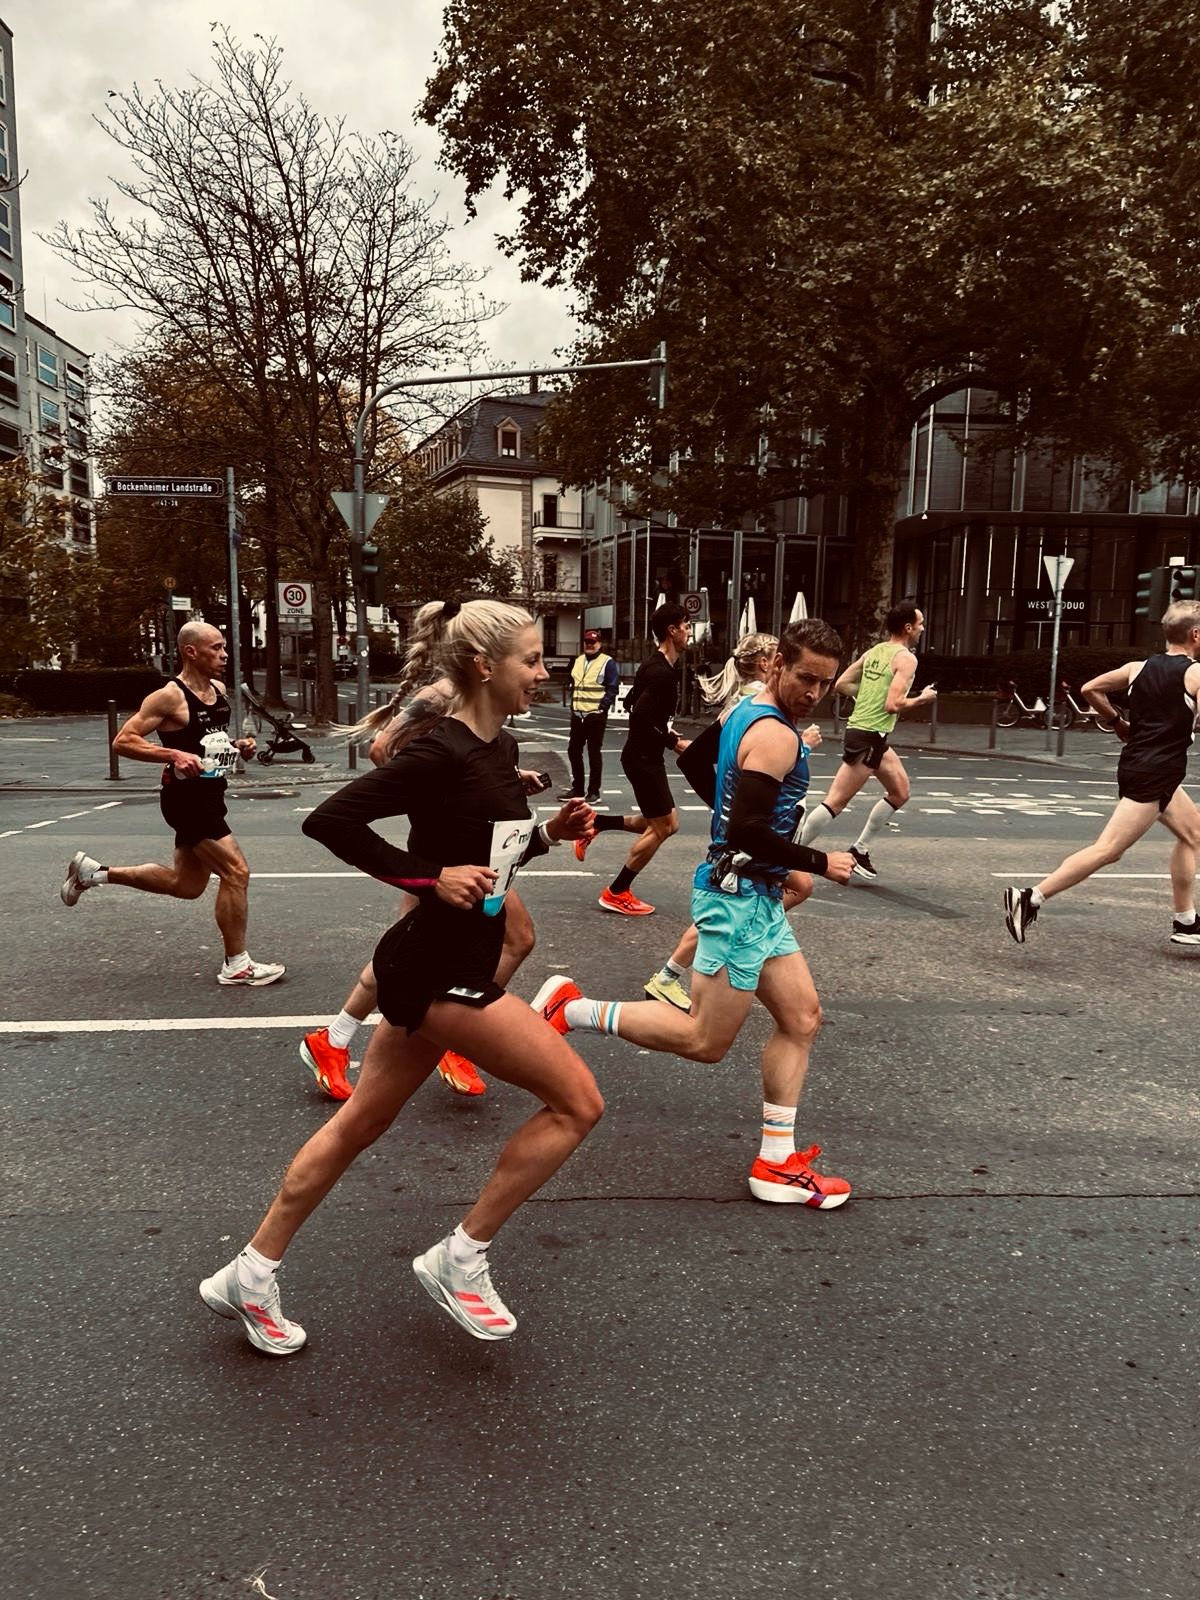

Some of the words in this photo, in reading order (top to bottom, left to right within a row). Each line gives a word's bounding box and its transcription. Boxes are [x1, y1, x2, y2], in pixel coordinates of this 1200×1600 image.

[117, 482, 169, 492] Bockenheimer
[171, 483, 212, 492] Landstraße
[288, 590, 302, 601] 30
[687, 599, 699, 609] 30
